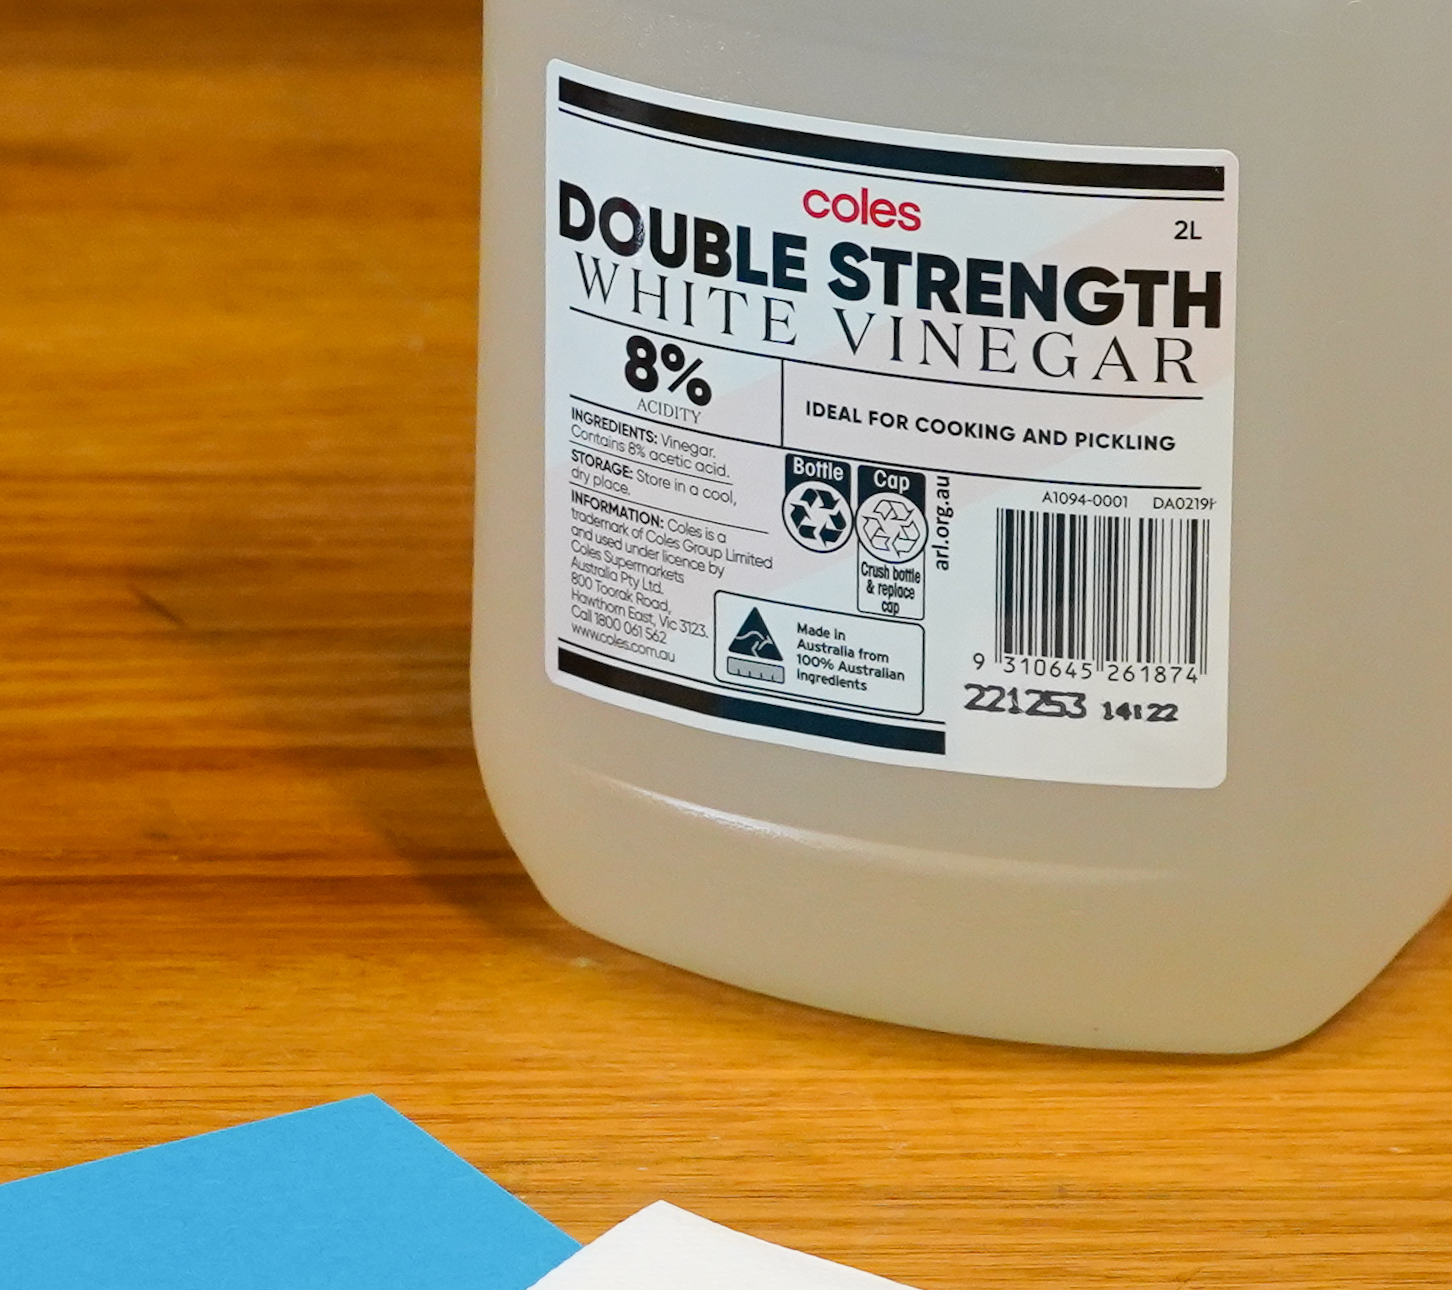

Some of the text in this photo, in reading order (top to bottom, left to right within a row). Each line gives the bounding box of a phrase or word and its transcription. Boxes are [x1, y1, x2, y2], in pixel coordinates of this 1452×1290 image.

[803, 187, 922, 232] coles
[1174, 220, 1202, 241] 2L
[559, 179, 1221, 329] DOUBLE STRENGTH
[575, 250, 1198, 384] WHITE VINEGAR
[624, 335, 713, 407] 8%
[636, 397, 702, 424] ACIDITY
[805, 400, 1176, 452] IDEAL FOR COOKING AND PICKLING
[571, 407, 716, 458] INGREDIENTS: Vinegar.
[571, 424, 730, 478] Contains 8% acetic acid.
[571, 449, 737, 507] STORAGE: Store in a cool,
[571, 467, 631, 496] dry place.
[793, 456, 844, 481] Bottle
[873, 469, 910, 494] Cap
[571, 490, 727, 544] INFORMATION: Coles is a
[1041, 491, 1128, 508] A1094-0001
[571, 507, 773, 570] trademark of Coles Group Limited
[932, 475, 954, 570] arl.org.au
[571, 525, 725, 579] and used under licence by
[571, 539, 685, 584] Coles Supermarkets
[861, 561, 921, 584] Crush bottle
[571, 556, 664, 596] Australia Pty Ltd.
[571, 571, 672, 615] 800 Toorak Road,
[866, 579, 915, 600] & replace
[571, 588, 709, 639] Hawthorn East, Vic 3123.
[571, 604, 668, 645] Call 1800 061 562
[881, 600, 900, 616] cap
[571, 622, 676, 663] www.coles.com.au
[797, 622, 846, 641] Made in
[797, 639, 889, 664] Australia from
[797, 653, 905, 682] 100% Australian
[973, 652, 1198, 683] 9 310645 261874
[964, 683, 1087, 719] 221253
